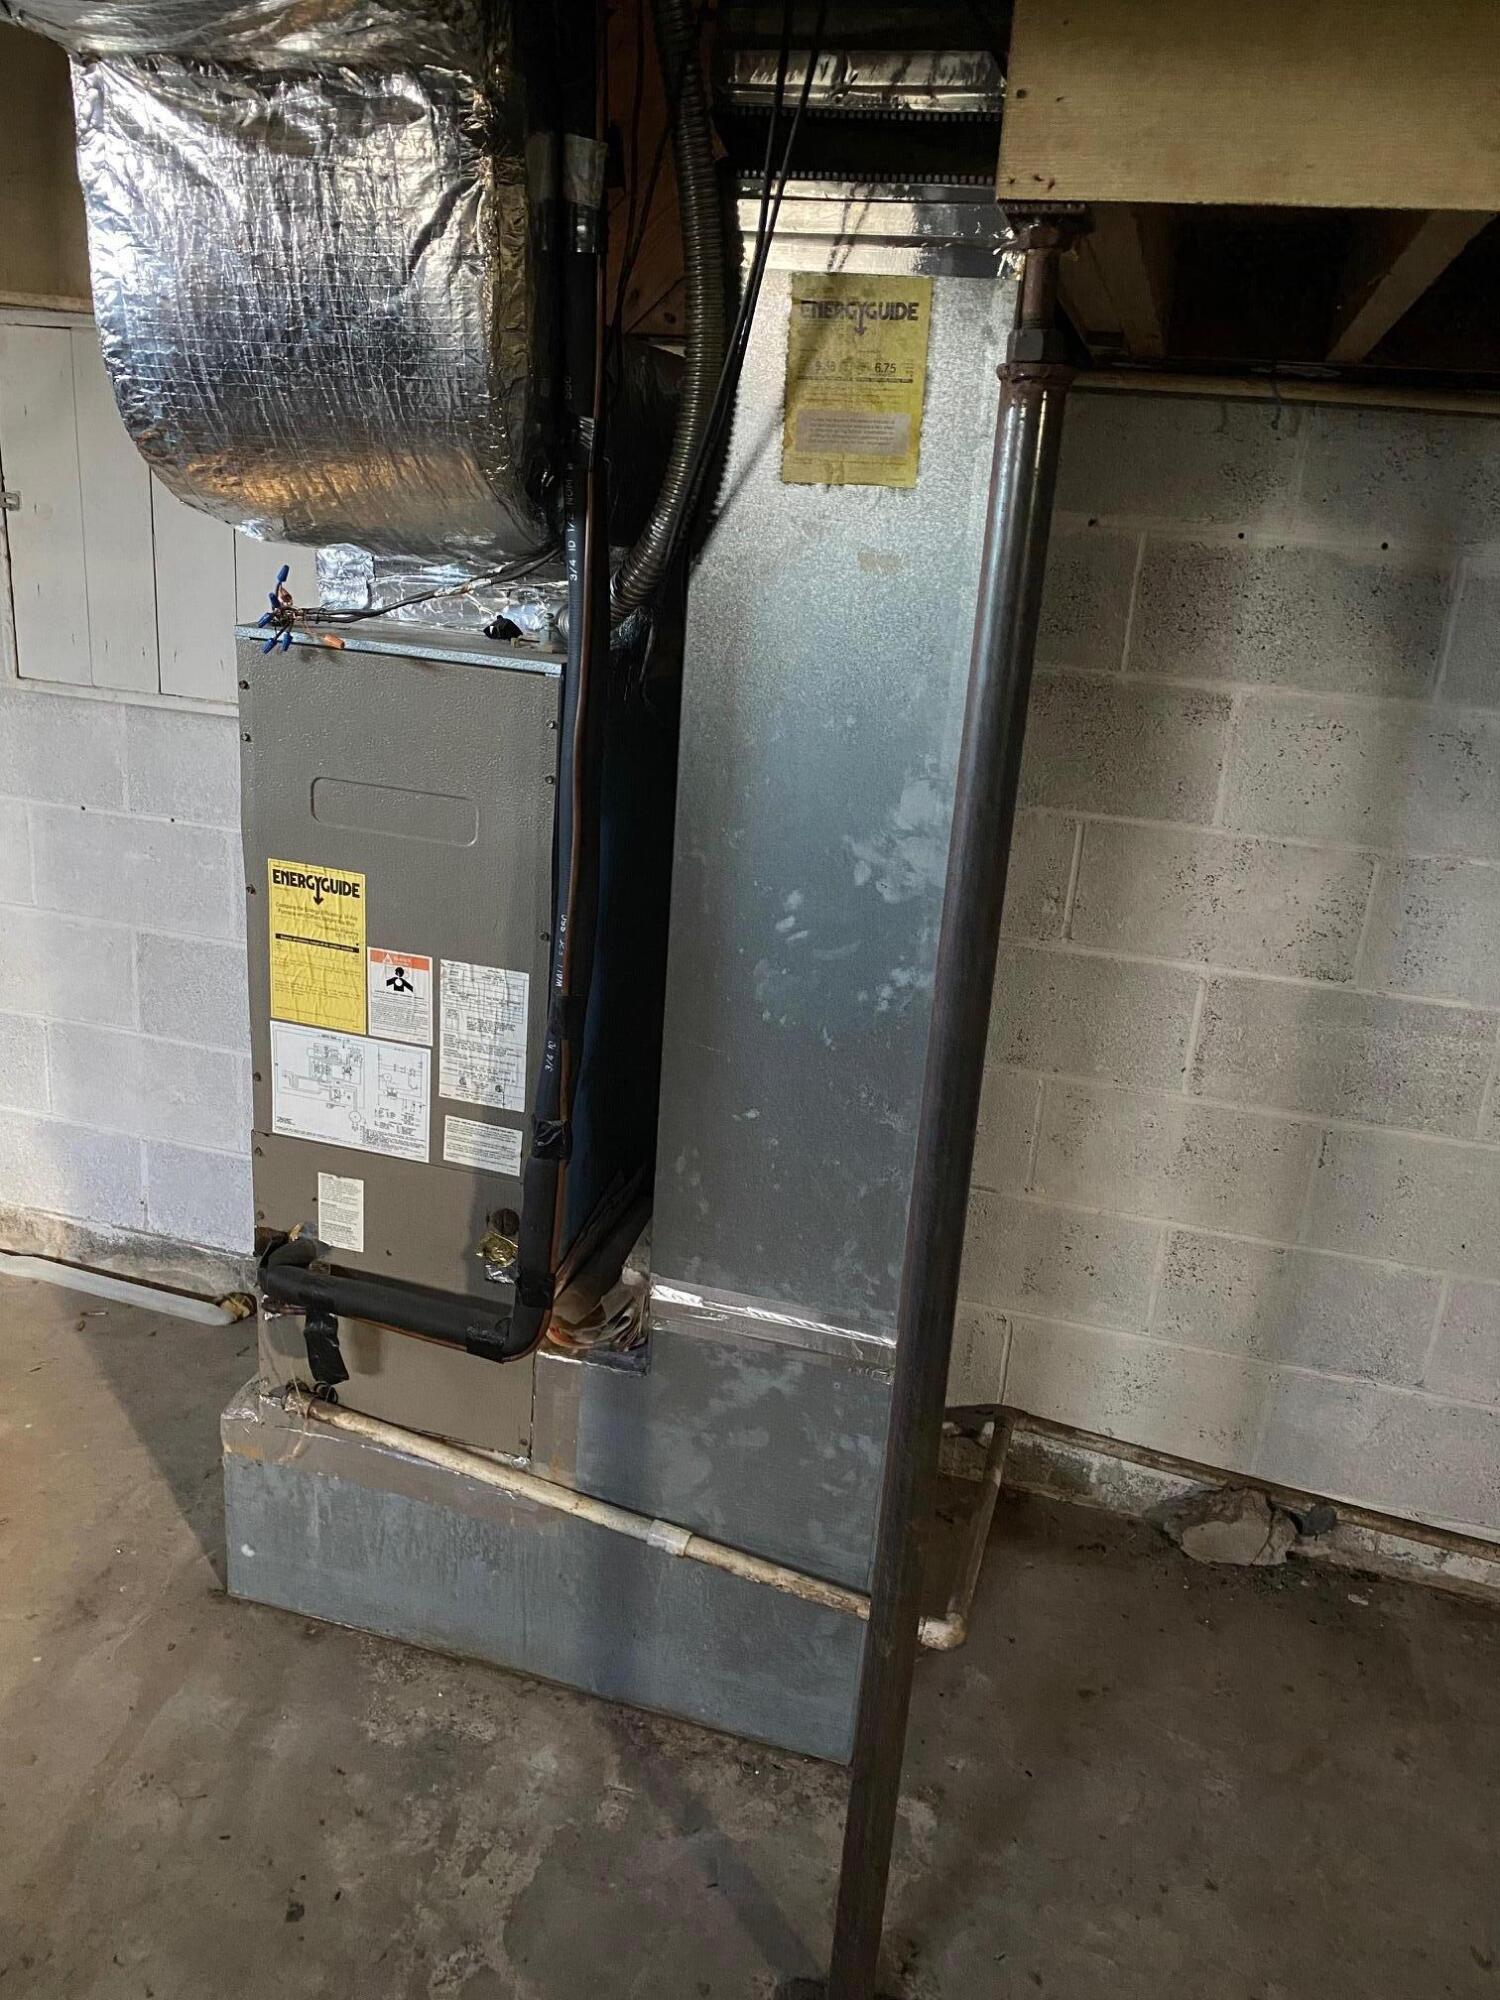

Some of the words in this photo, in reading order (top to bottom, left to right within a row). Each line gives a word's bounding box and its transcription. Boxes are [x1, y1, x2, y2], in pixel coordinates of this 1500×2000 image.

[874, 363, 897, 374] 6.75
[567, 540, 577, 551] ID
[569, 560, 578, 581] 3/4
[272, 869, 361, 898] ENERGYGUIDE
[544, 1053, 554, 1072] 3/4
